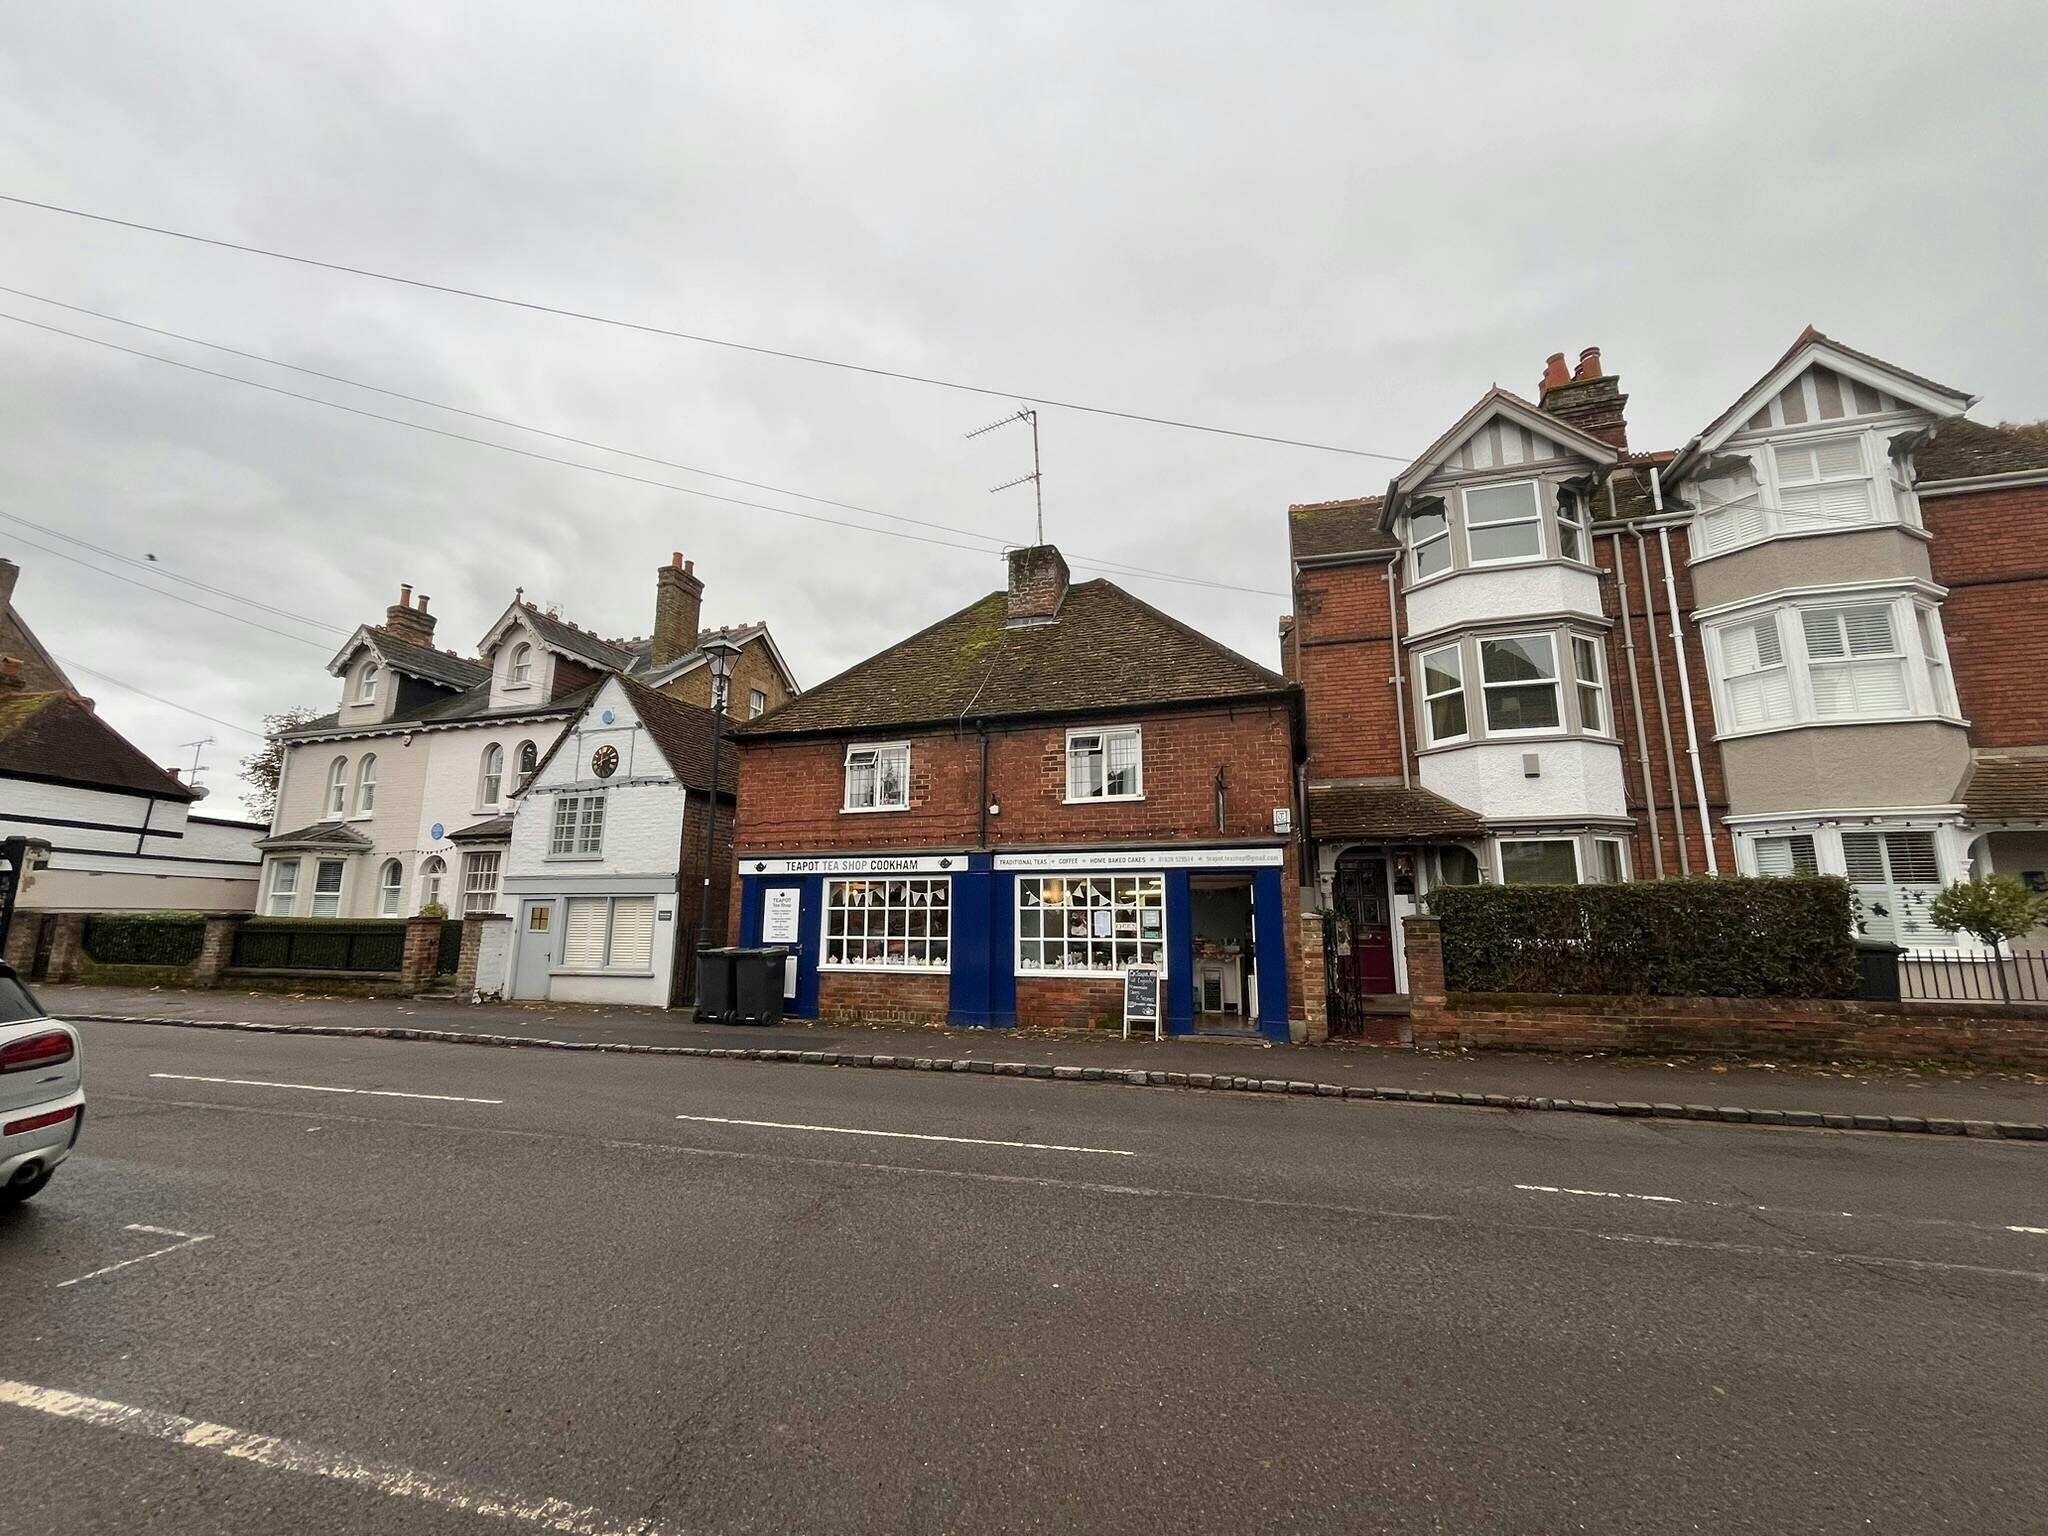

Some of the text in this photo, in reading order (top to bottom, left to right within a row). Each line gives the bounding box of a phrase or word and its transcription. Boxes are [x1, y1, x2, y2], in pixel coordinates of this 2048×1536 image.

[786, 859, 918, 871] TEAPOT TEA SHOP COOKHAM
